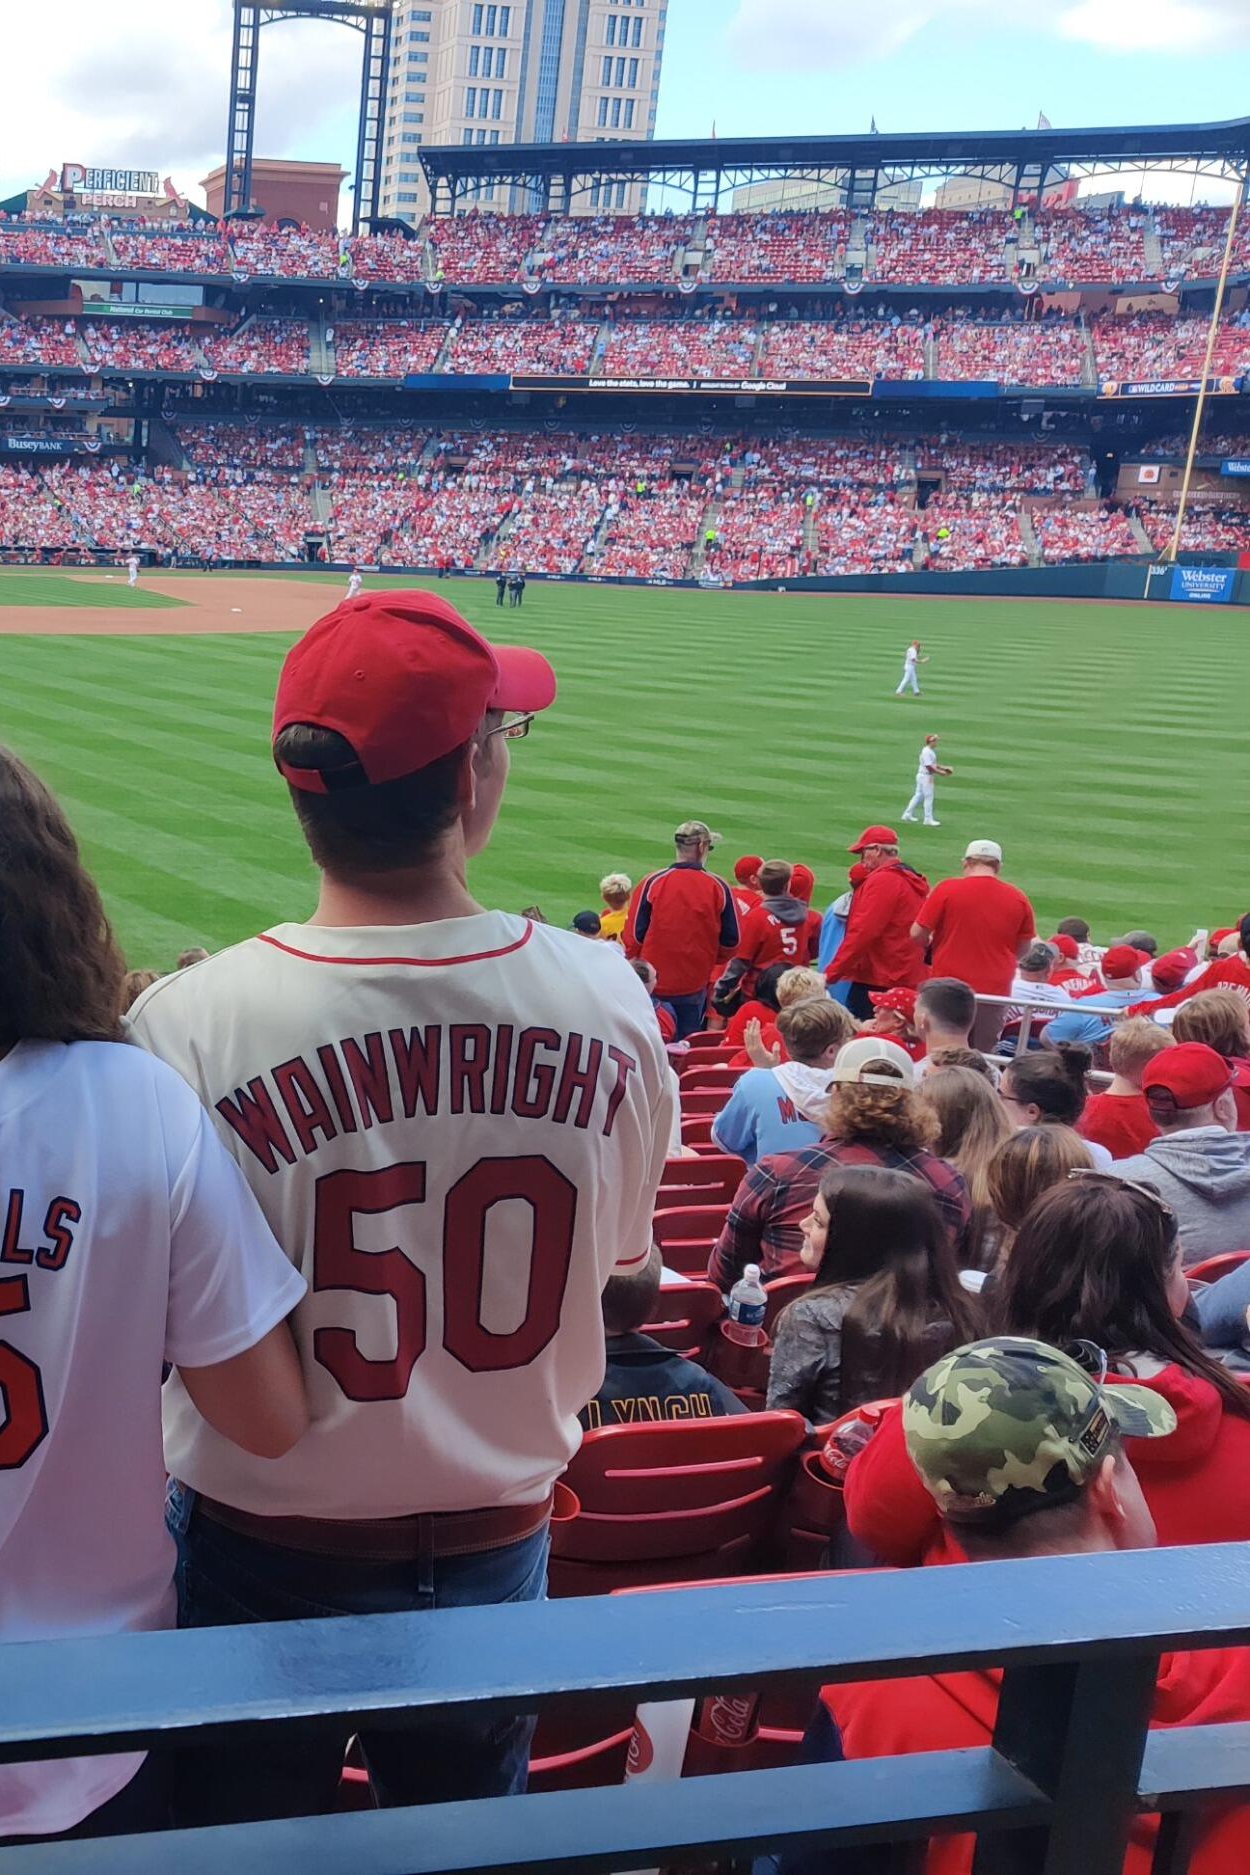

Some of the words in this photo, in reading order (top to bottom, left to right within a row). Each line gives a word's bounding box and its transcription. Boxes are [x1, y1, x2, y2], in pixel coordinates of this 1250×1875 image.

[62, 163, 159, 193] PERFICIENT
[81, 194, 138, 208] PERCH
[1138, 383, 1155, 393] WILD
[1155, 383, 1174, 393] CARD
[1182, 569, 1227, 582] Webster
[1182, 582, 1225, 590] UNIVERSITY
[780, 927, 798, 955] 5
[215, 1023, 637, 1175] WAINWRIGHT
[313, 1154, 578, 1402] 50
